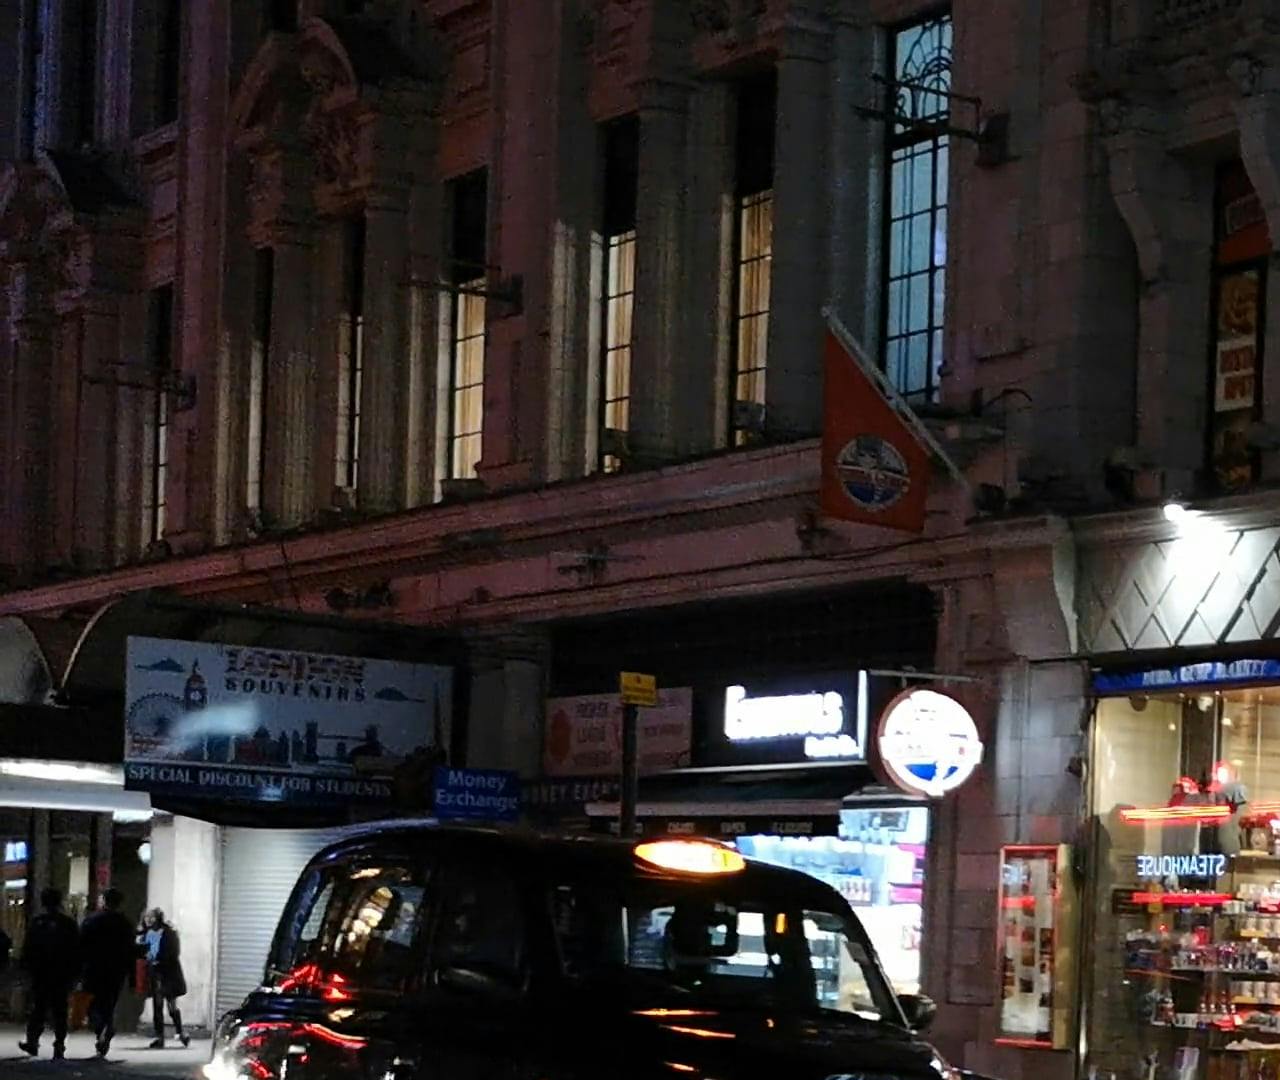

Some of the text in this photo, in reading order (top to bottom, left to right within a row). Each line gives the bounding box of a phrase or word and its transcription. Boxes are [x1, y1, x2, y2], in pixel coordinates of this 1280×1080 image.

[226, 677, 366, 703] SOUVENIRS
[128, 766, 392, 798] SPECIAL DISCOUNT FOR STUDENTS
[448, 770, 507, 790] Money
[435, 788, 518, 813] Exchange
